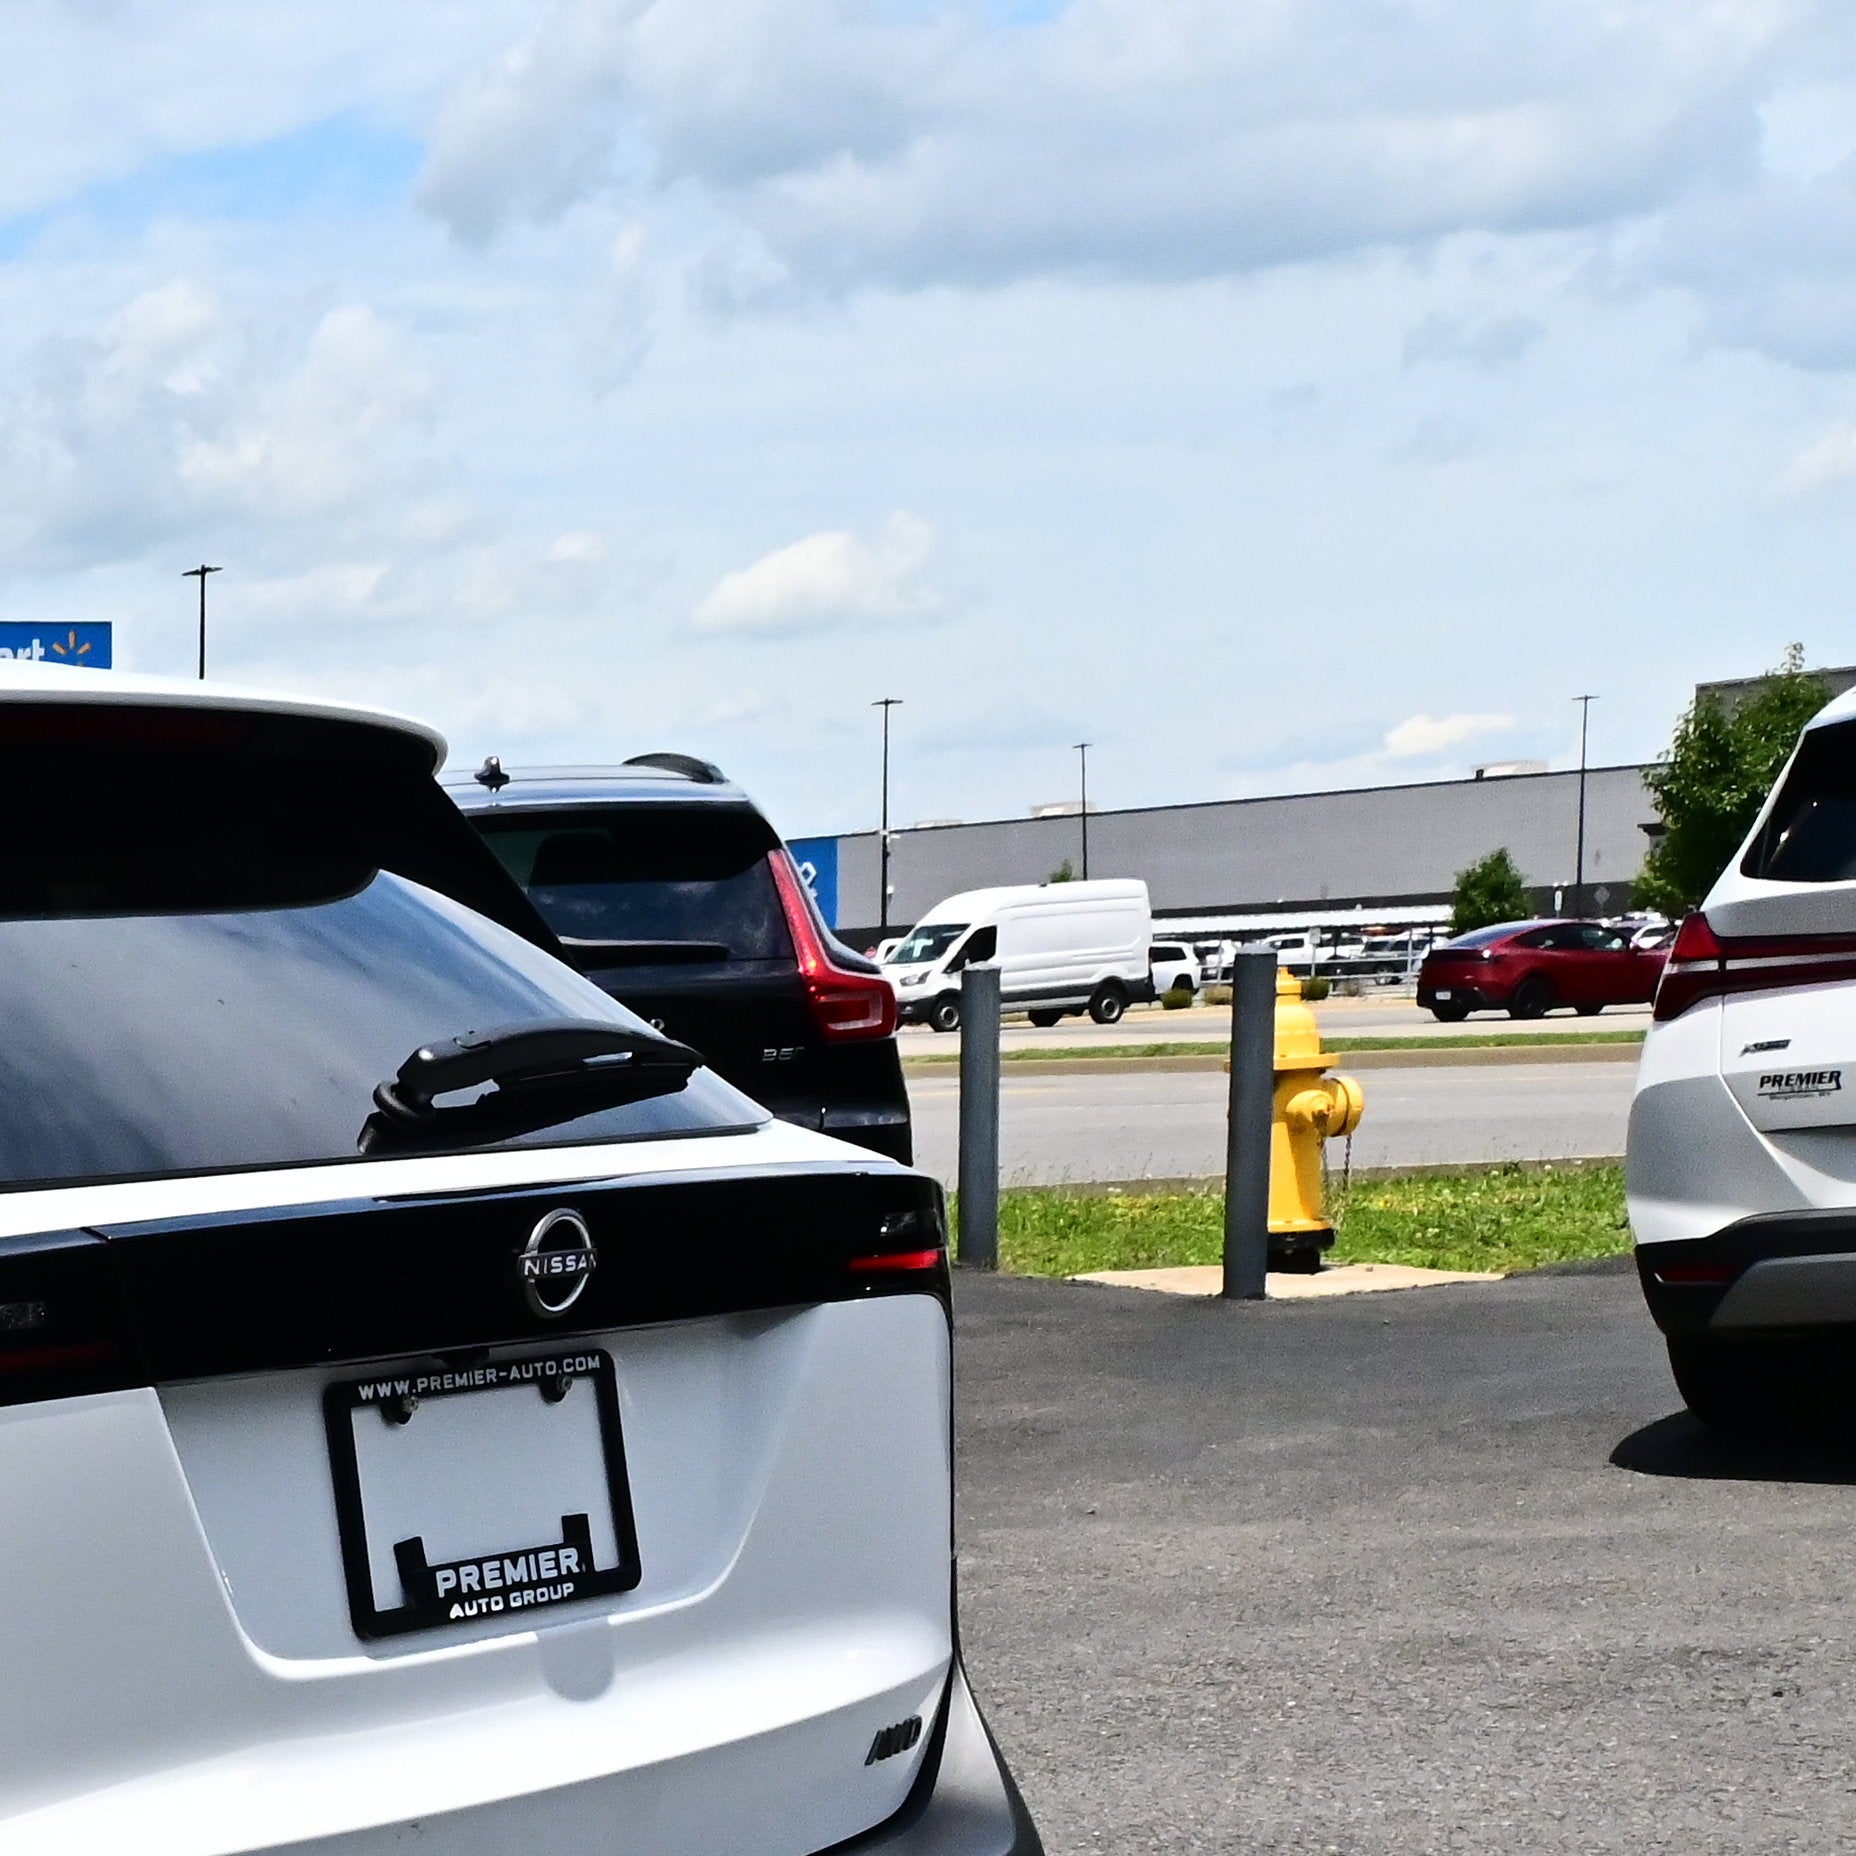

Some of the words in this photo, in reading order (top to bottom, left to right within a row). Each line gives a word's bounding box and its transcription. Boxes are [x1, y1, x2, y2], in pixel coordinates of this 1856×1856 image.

[1758, 1070, 1842, 1090] PREMIER
[524, 1253, 597, 1276] NISSAN
[358, 1355, 602, 1401] WWW.PREMIER-AUTO.COM
[435, 1547, 581, 1598] PREMIER
[449, 1595, 505, 1619] AUTO
[509, 1582, 575, 1610] GROUP
